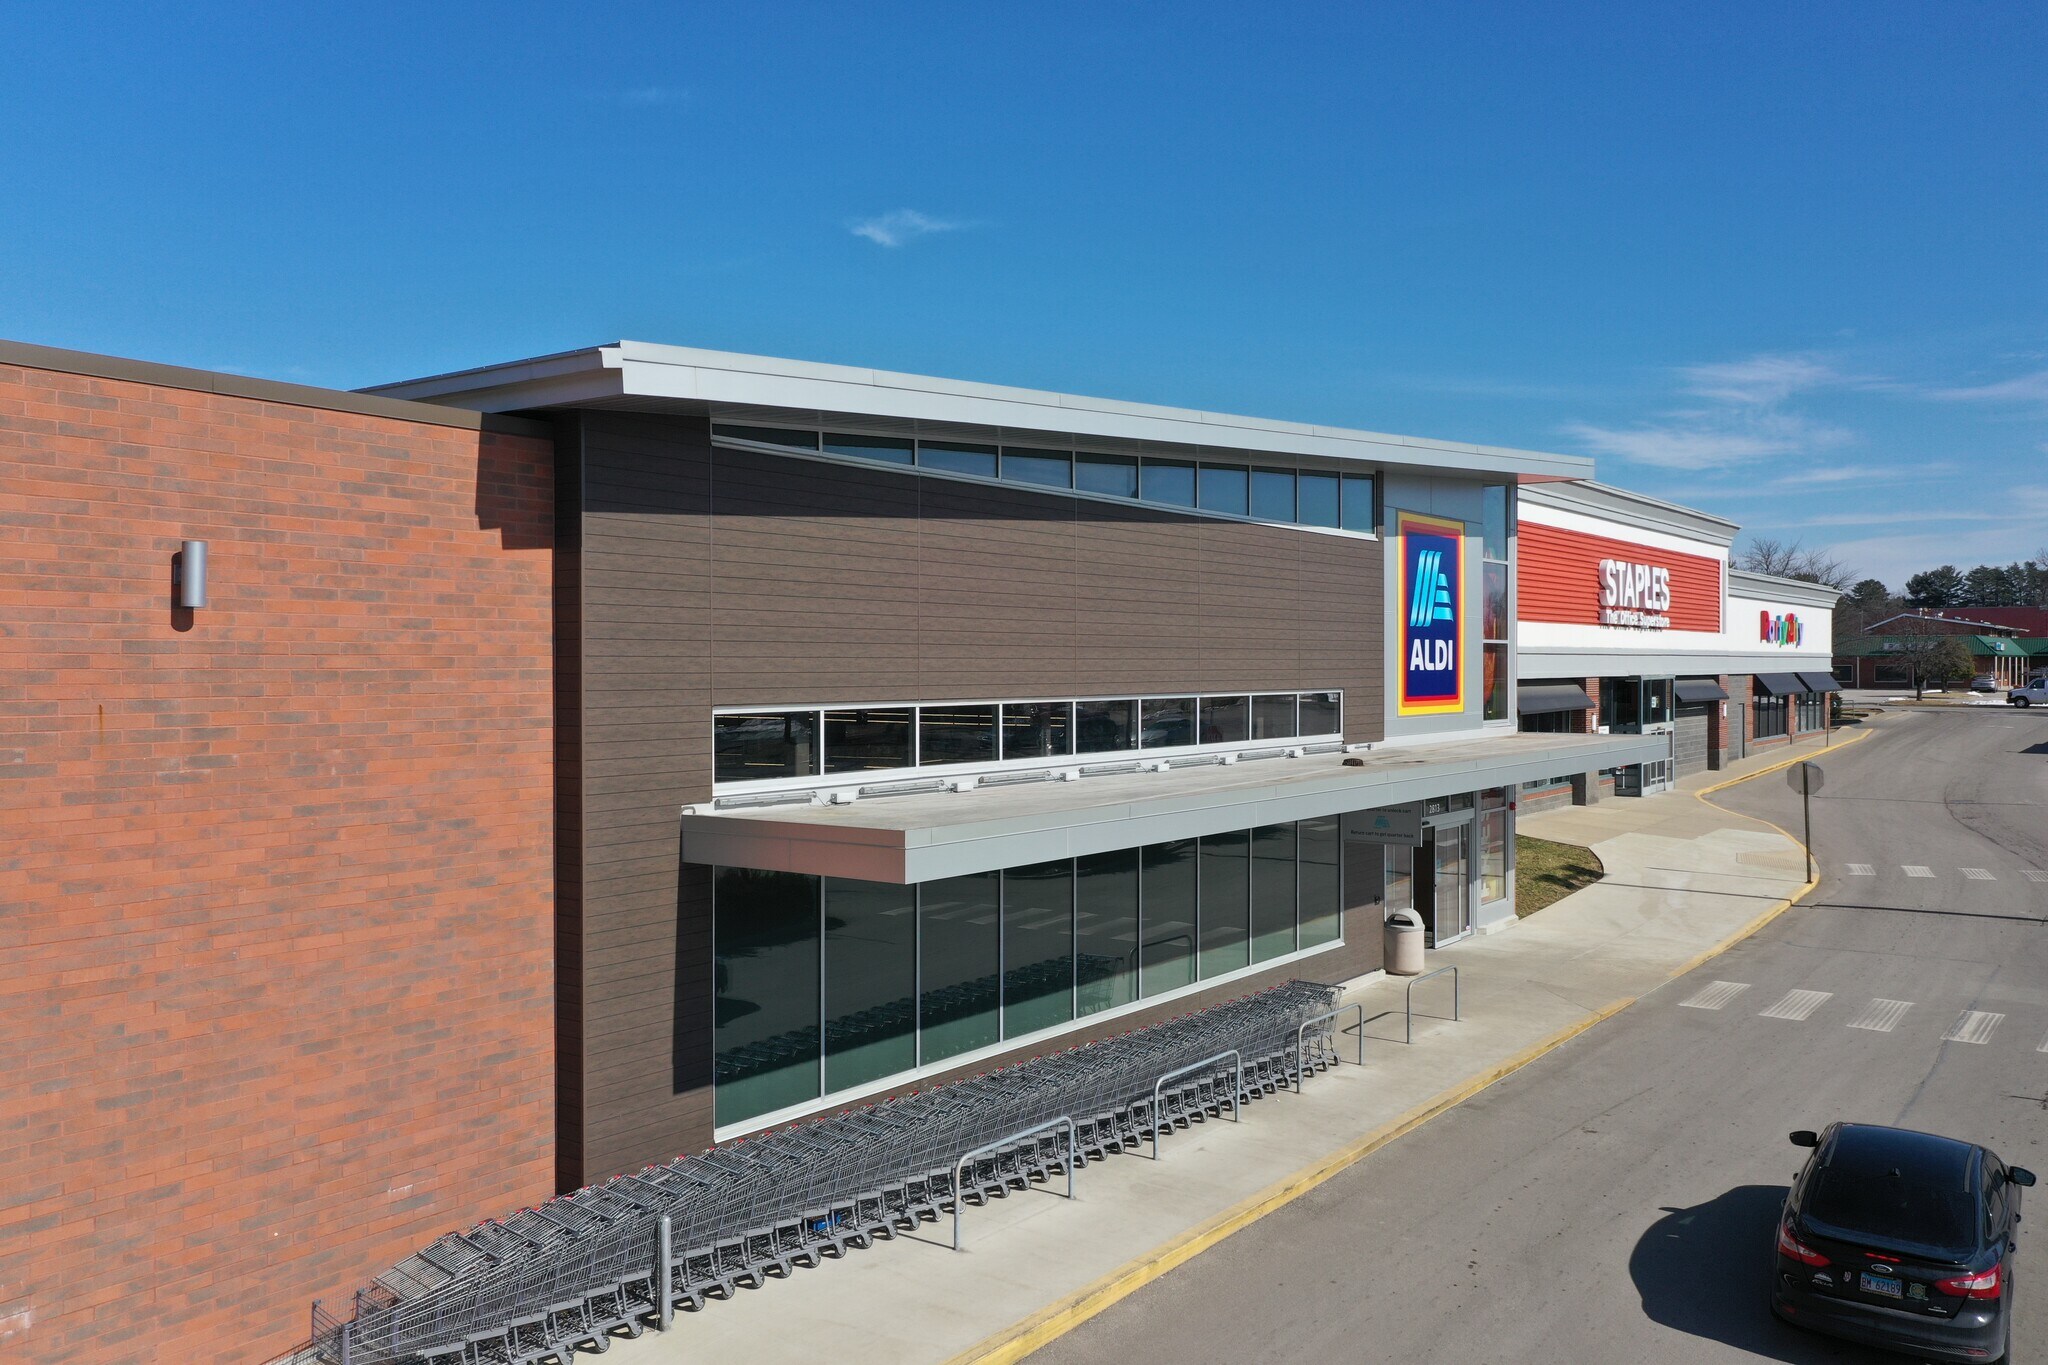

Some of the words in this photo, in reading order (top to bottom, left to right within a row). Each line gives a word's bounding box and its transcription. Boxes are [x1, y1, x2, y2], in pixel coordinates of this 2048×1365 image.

[1599, 559, 1670, 611] STAPLES
[1602, 608, 1618, 624] The
[1620, 611, 1638, 626] Office
[1409, 638, 1453, 671] ALDI
[1875, 1280, 1901, 1294] 62189
